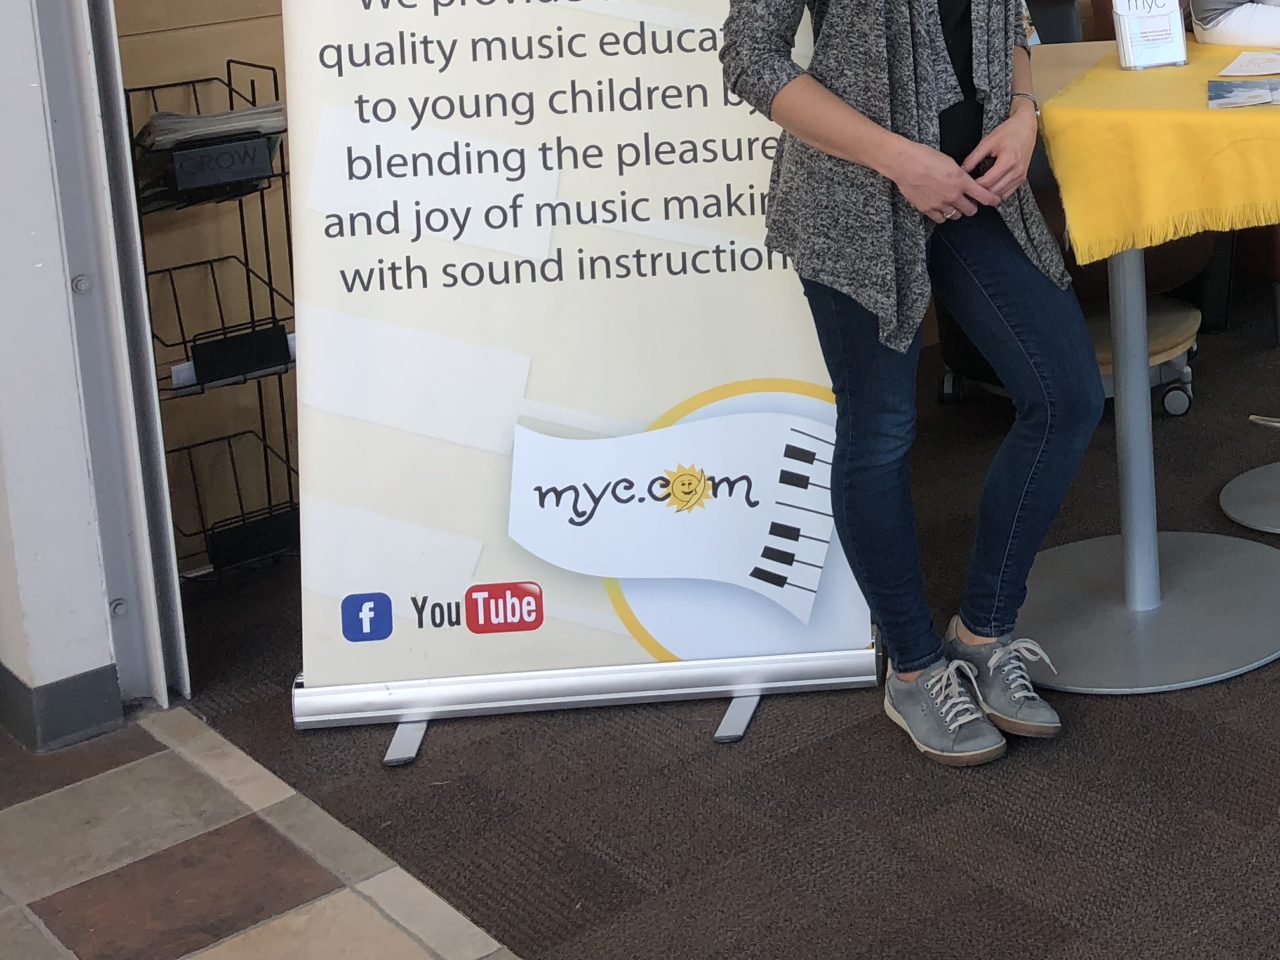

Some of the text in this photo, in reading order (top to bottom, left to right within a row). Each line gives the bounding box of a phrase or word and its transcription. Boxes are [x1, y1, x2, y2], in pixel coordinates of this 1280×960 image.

[319, 20, 723, 77] quality music educa
[355, 77, 756, 130] to young children b
[347, 132, 778, 182] blending the pleasure
[325, 184, 768, 243] and joy of music maki
[340, 256, 428, 293] with
[442, 248, 564, 288] sound
